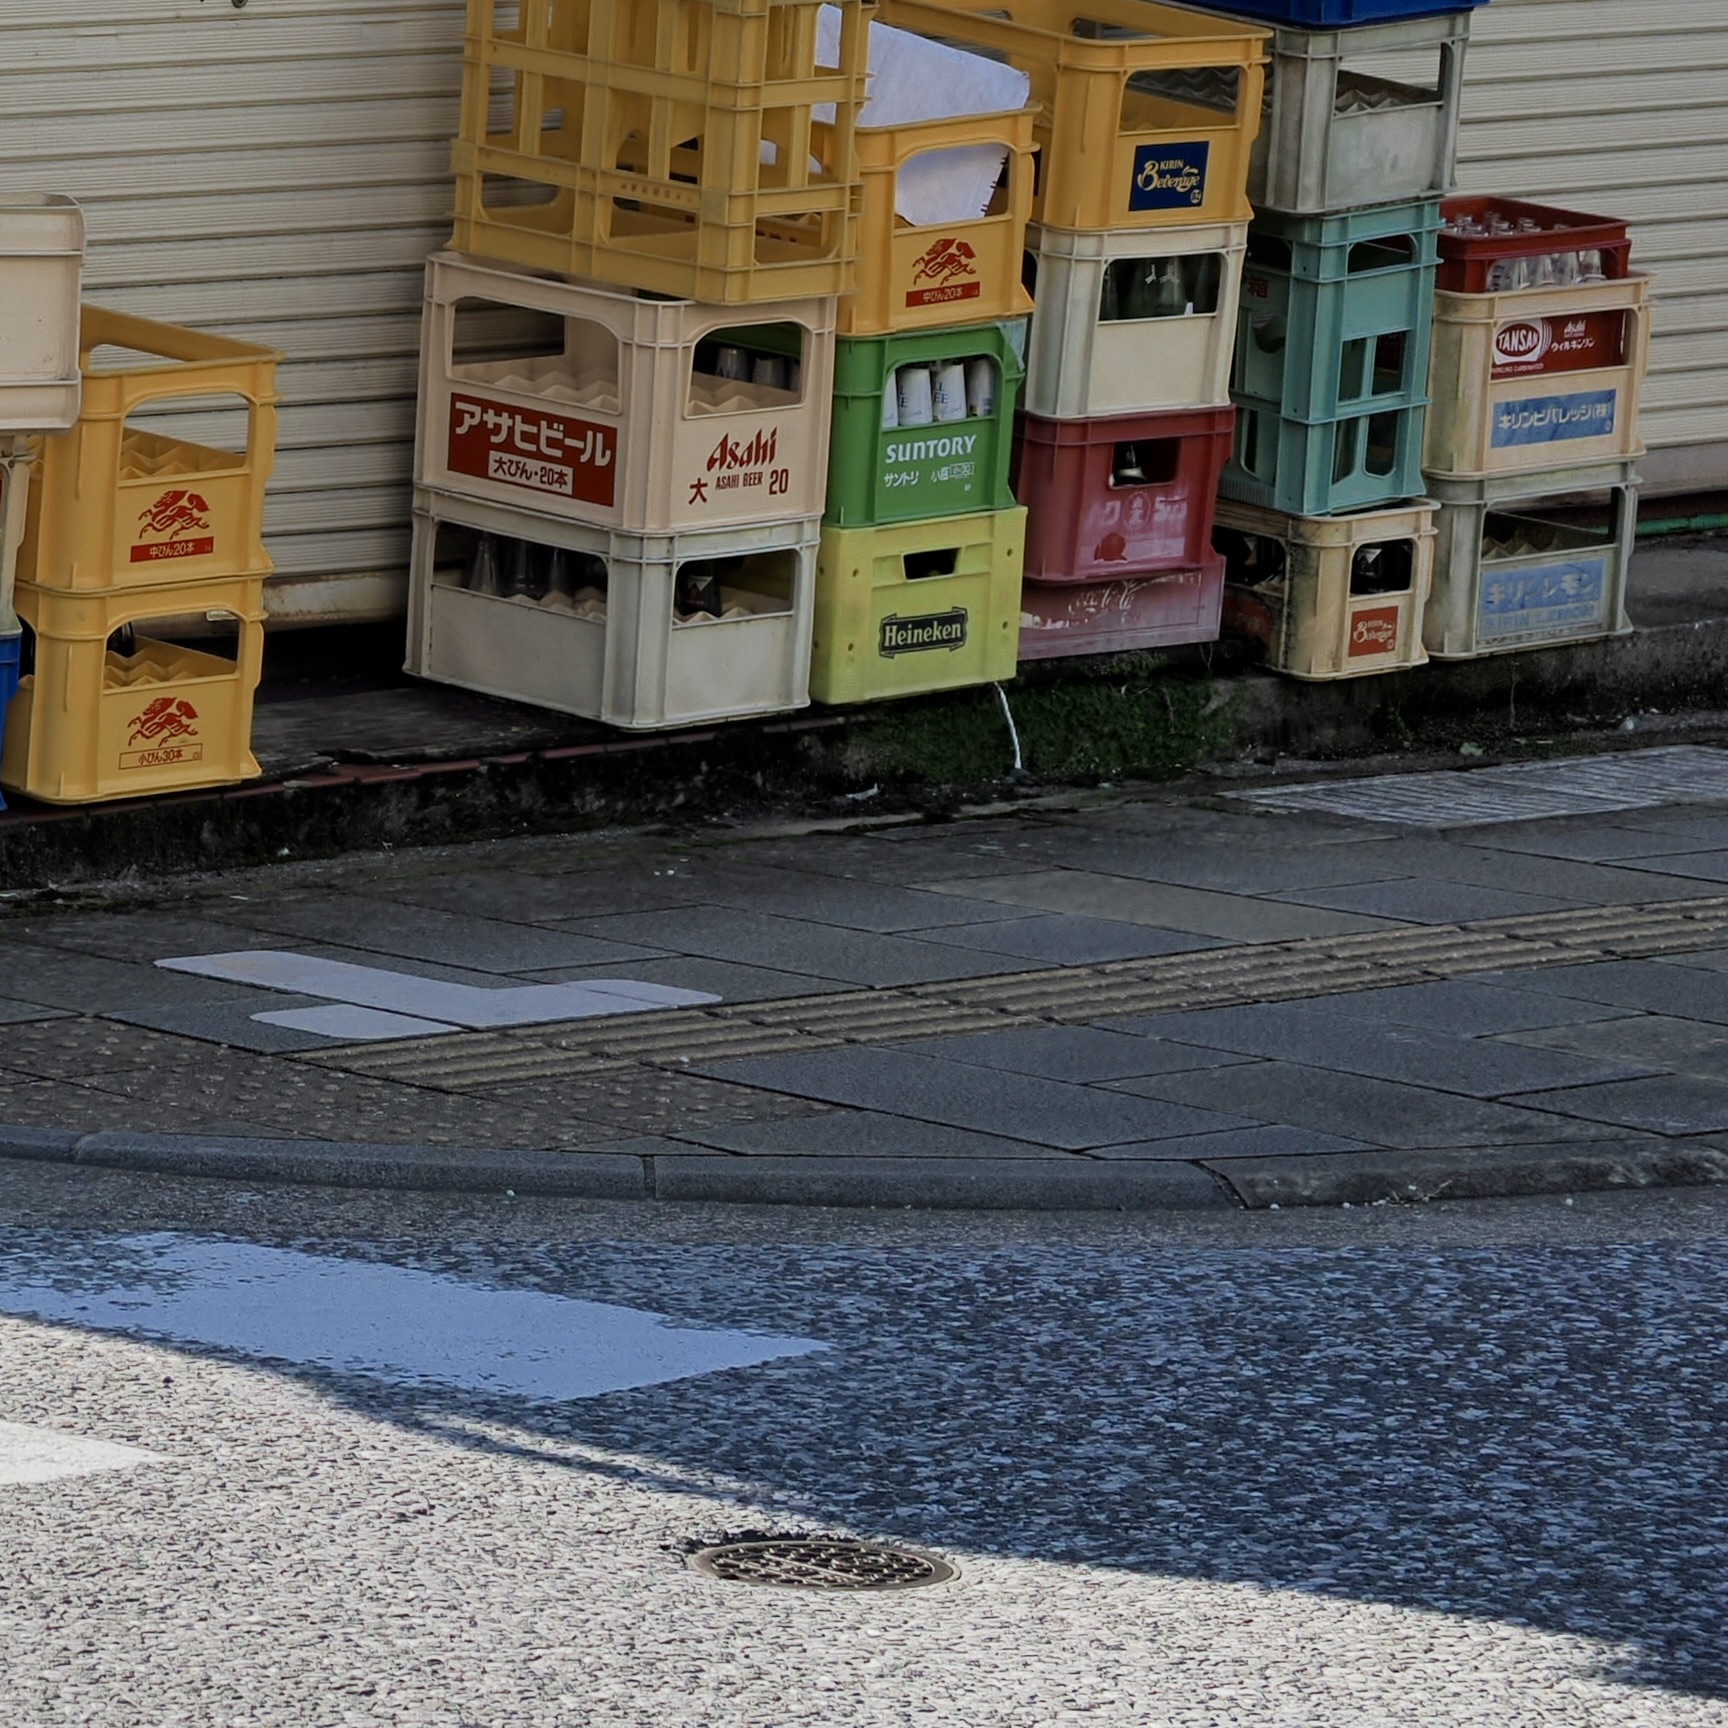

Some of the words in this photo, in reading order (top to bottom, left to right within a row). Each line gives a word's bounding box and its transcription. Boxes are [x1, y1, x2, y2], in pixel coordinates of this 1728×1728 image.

[1136, 160, 1201, 193] Beverage
[1159, 159, 1184, 171] KIRIN
[922, 286, 964, 302] 中びん20本
[1497, 328, 1539, 352] TANSAN
[1497, 402, 1611, 430] キリンビバレッジ(株)
[454, 401, 613, 467] アサヒビール
[706, 425, 779, 473] Asahi
[885, 434, 978, 464] SUNTORY
[492, 455, 569, 489] 大びん・20本
[688, 477, 708, 505] 大
[715, 472, 740, 491] ASAHI
[742, 470, 764, 489] BEER
[768, 467, 790, 496] 20
[149, 541, 195, 558] 中びん20本
[883, 620, 962, 647] Heineken
[138, 747, 184, 766] 小びん30本
